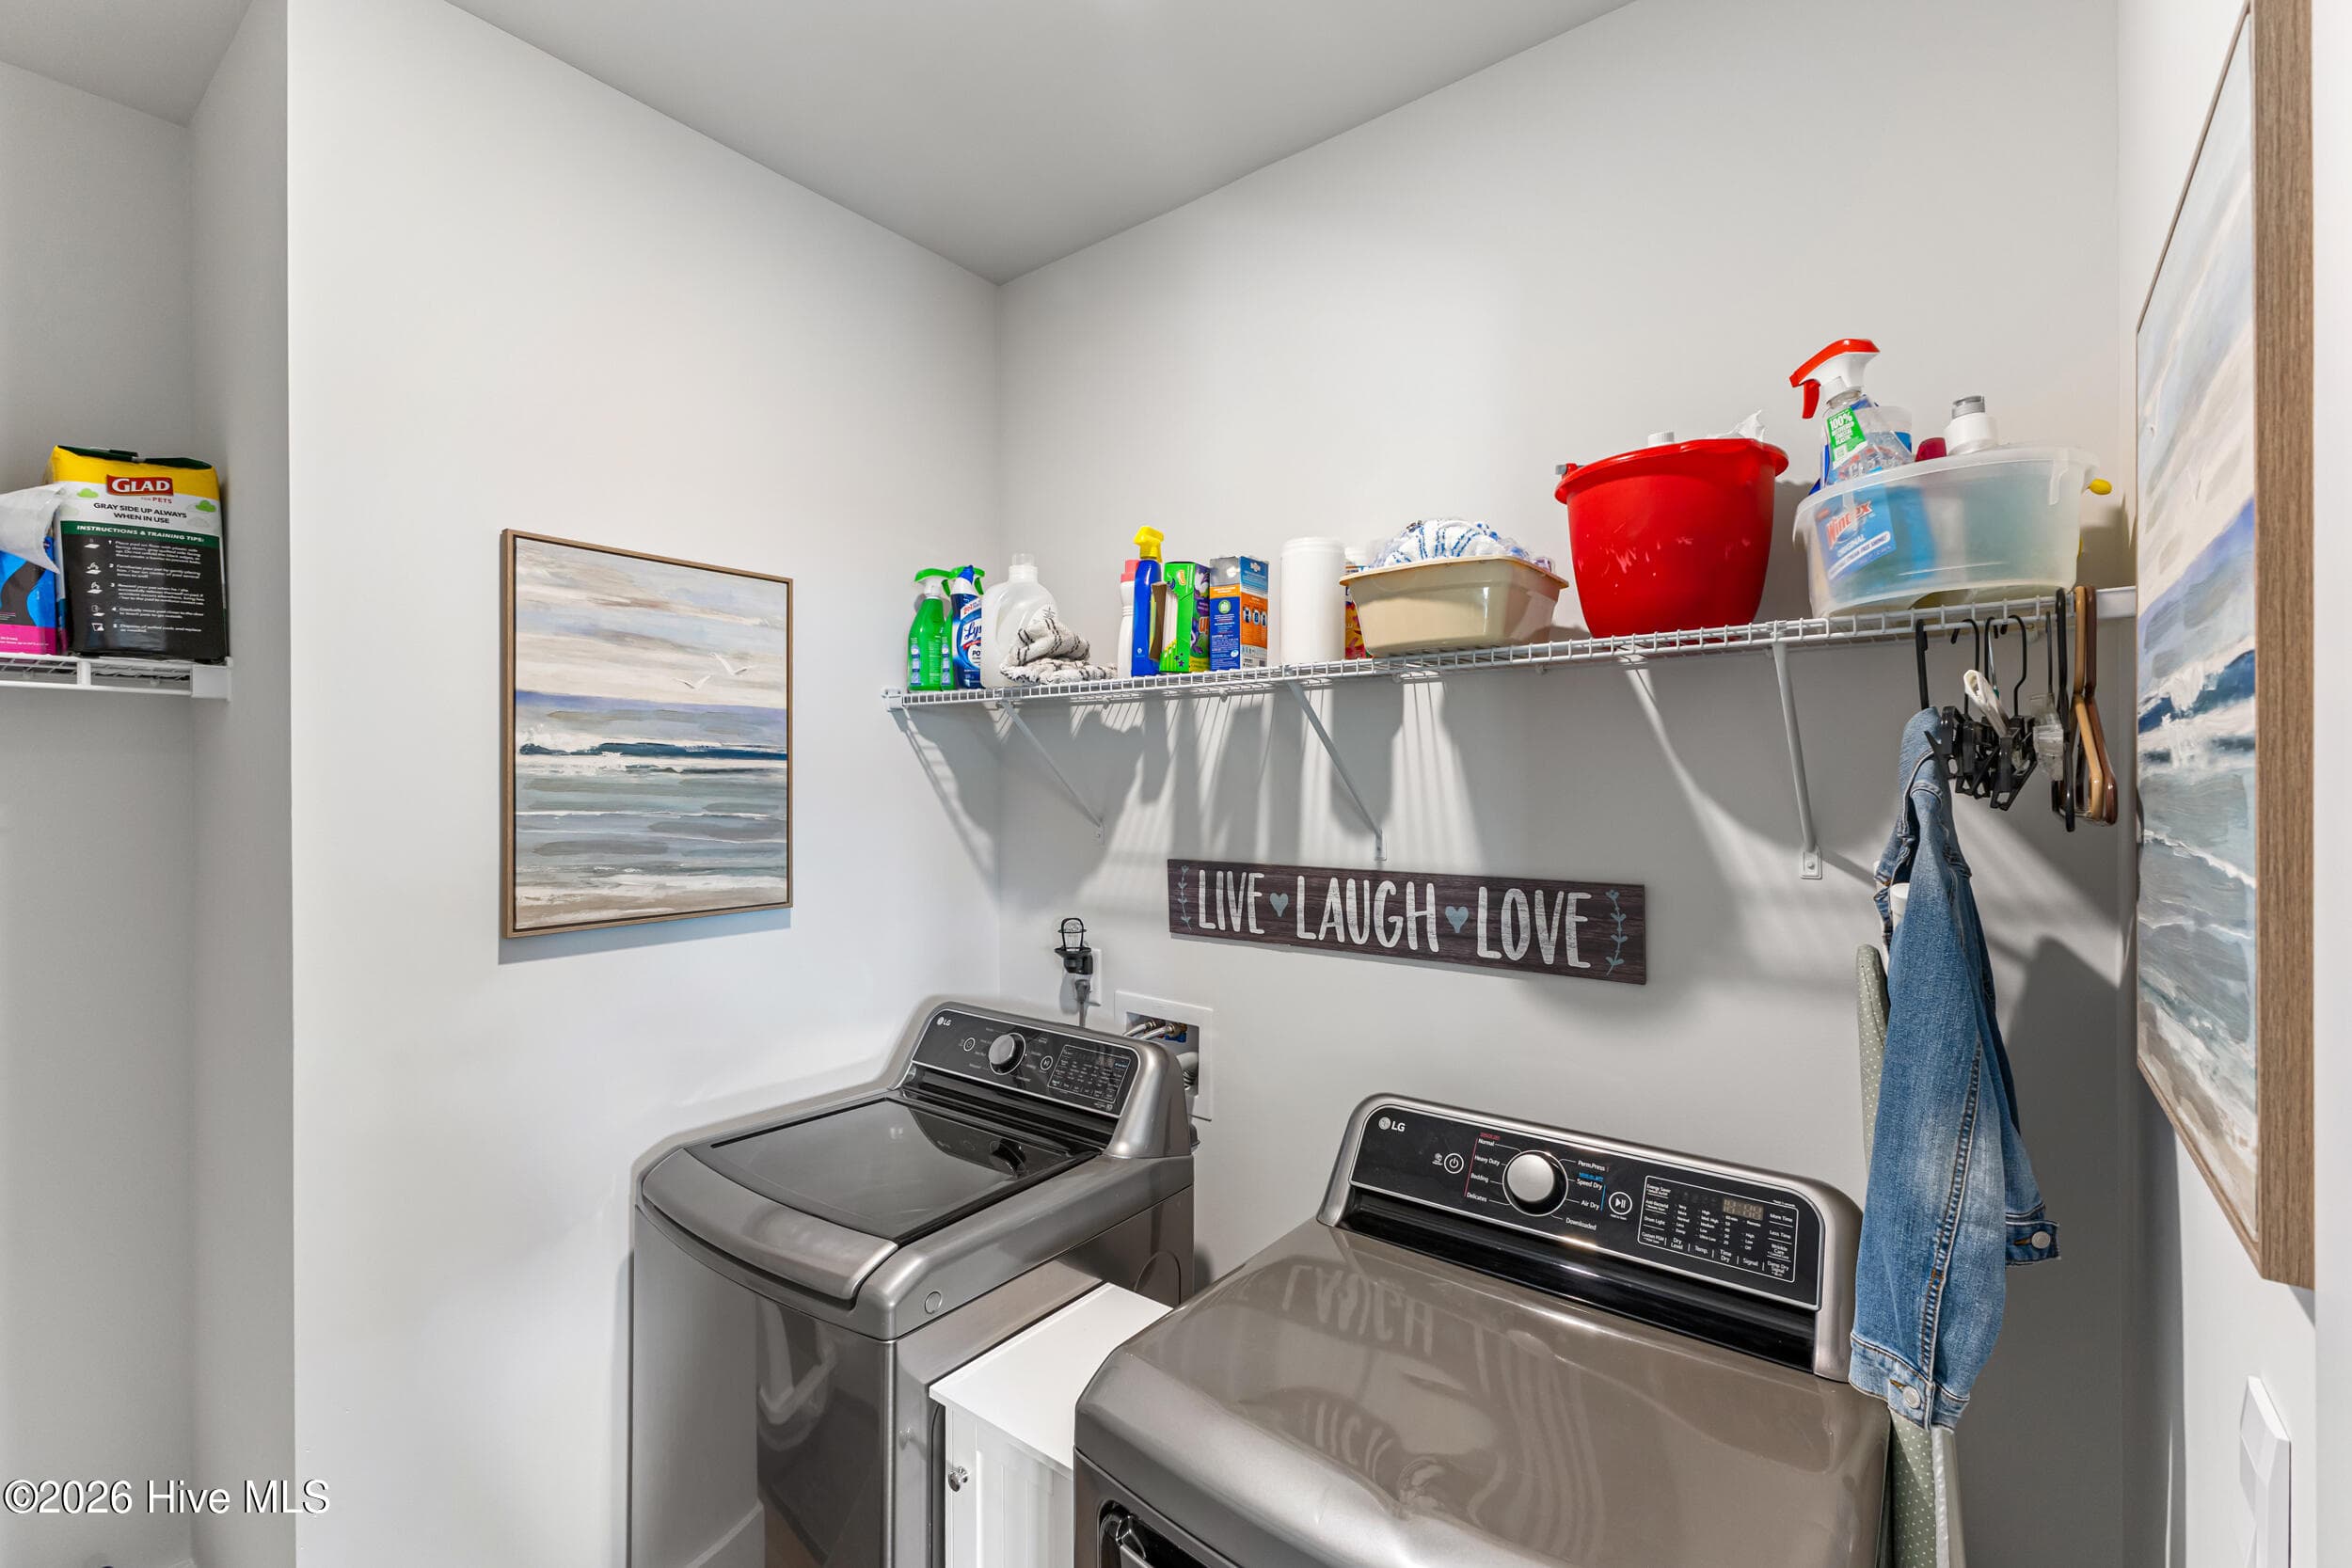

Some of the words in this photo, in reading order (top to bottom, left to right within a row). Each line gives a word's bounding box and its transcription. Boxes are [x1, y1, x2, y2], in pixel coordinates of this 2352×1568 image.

[1829, 412, 1853, 431] 100%
[111, 478, 170, 493] GLAD
[93, 502, 119, 511] GRAY
[153, 509, 187, 518] ALWAYS
[113, 513, 142, 521] WHEN
[77, 525, 138, 535] INSTRUCTIONS
[147, 531, 185, 541] TRAINING
[1199, 869, 1265, 935] LIVE
[1296, 876, 1439, 953] LAUGH
[1477, 886, 1592, 969] LOVE
[1391, 1121, 1406, 1132] LG
[1478, 1138, 1495, 1147] Normal
[1474, 1155, 1488, 1164] Heavy
[1489, 1157, 1500, 1166] Duty
[1470, 1173, 1488, 1182] Bedding
[1577, 1178, 1592, 1186] Speed
[1593, 1181, 1602, 1190] Dry
[1467, 1192, 1487, 1202] Delicates
[1590, 1202, 1599, 1211] Dry
[1565, 1217, 1597, 1230] Downloaded
[1742, 1258, 1758, 1266] Signal
